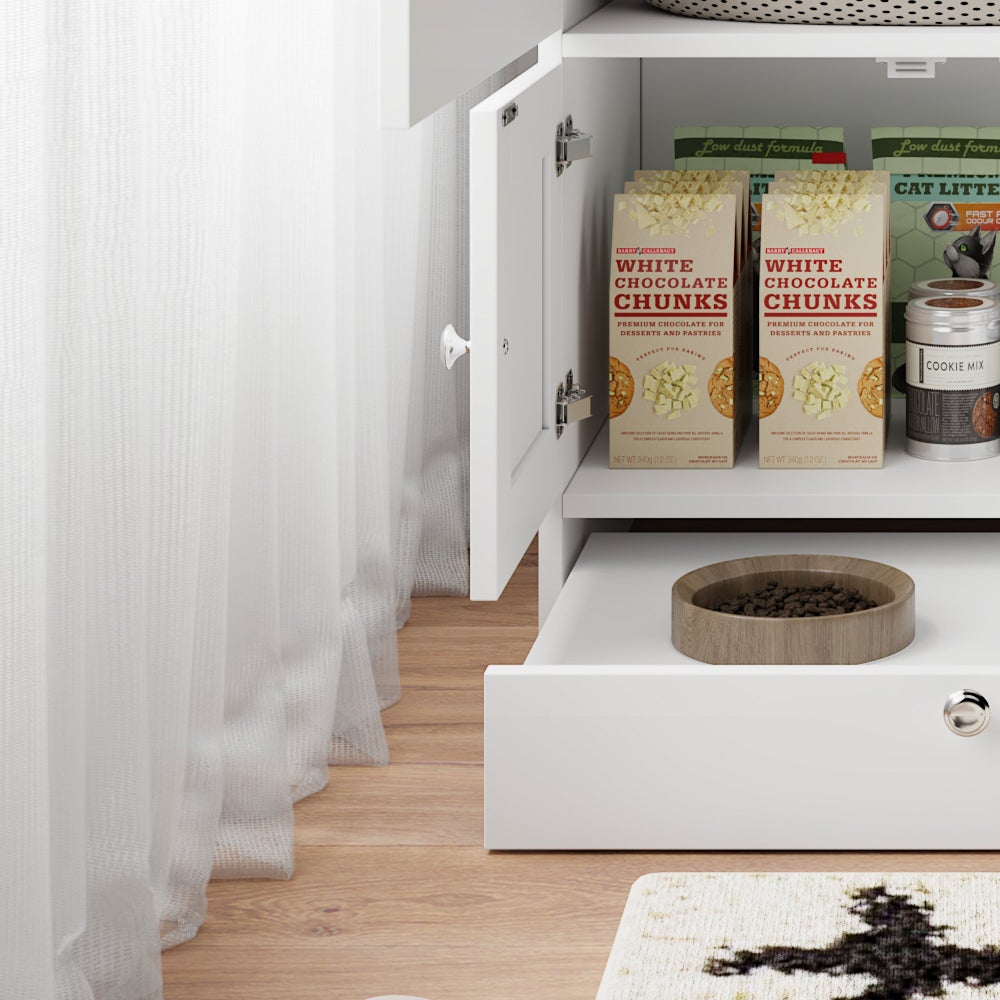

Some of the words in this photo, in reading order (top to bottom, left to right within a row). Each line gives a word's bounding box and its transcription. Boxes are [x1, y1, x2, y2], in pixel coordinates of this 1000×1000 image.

[695, 139, 730, 157] Low
[734, 139, 763, 152] dust
[765, 140, 824, 158] formula
[893, 139, 928, 157] Low
[931, 139, 961, 152] dust
[894, 182, 934, 195] CAT
[966, 210, 993, 218] FAST
[616, 260, 693, 273] WHITE
[765, 260, 843, 273] WHITE
[615, 278, 728, 289] CHOCOLATE
[764, 277, 877, 289] CHOCOLATE
[614, 294, 728, 310] CHUNKS
[764, 294, 877, 310] CHUNKS
[926, 360, 964, 371] COOKIE
[967, 360, 984, 371] MIX
